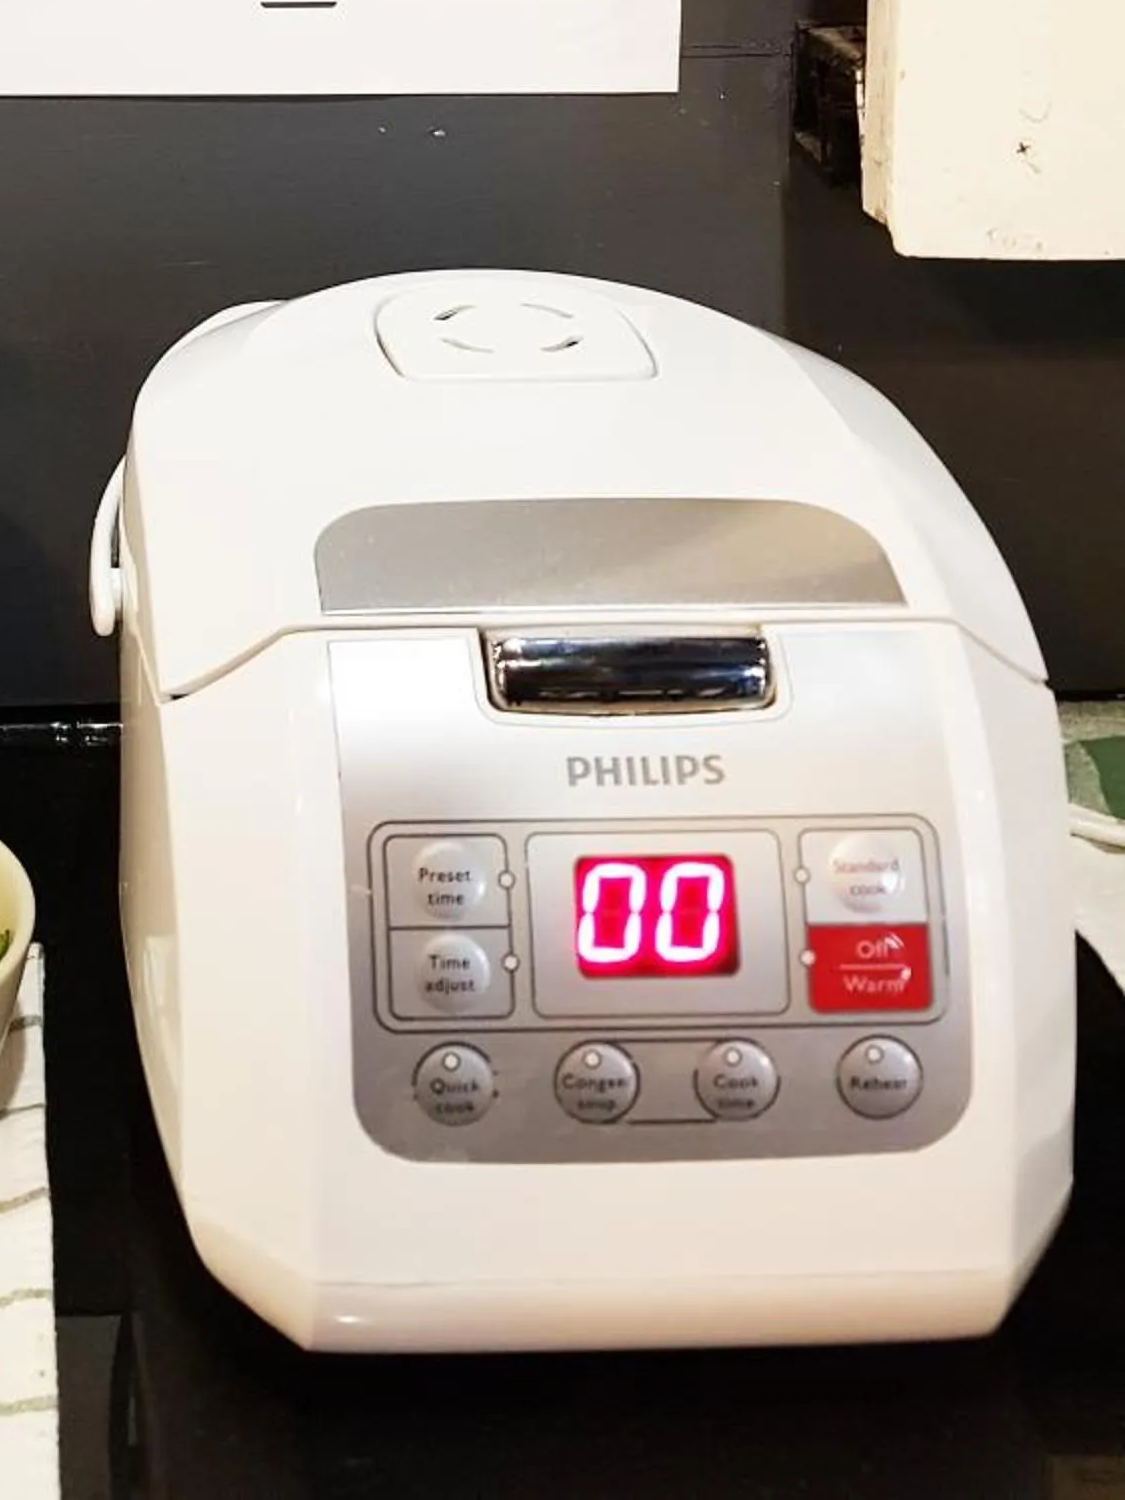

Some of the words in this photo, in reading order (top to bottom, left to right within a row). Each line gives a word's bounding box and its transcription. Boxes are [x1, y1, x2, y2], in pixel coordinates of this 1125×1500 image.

[567, 755, 725, 787] PHILIPS
[418, 867, 471, 883] Preset
[427, 893, 465, 906] time
[577, 862, 726, 964] 00
[429, 954, 471, 970] Time
[425, 978, 476, 996] adjust
[842, 975, 906, 994] Warm
[430, 1078, 480, 1095] Quick
[714, 1074, 759, 1089] Cook
